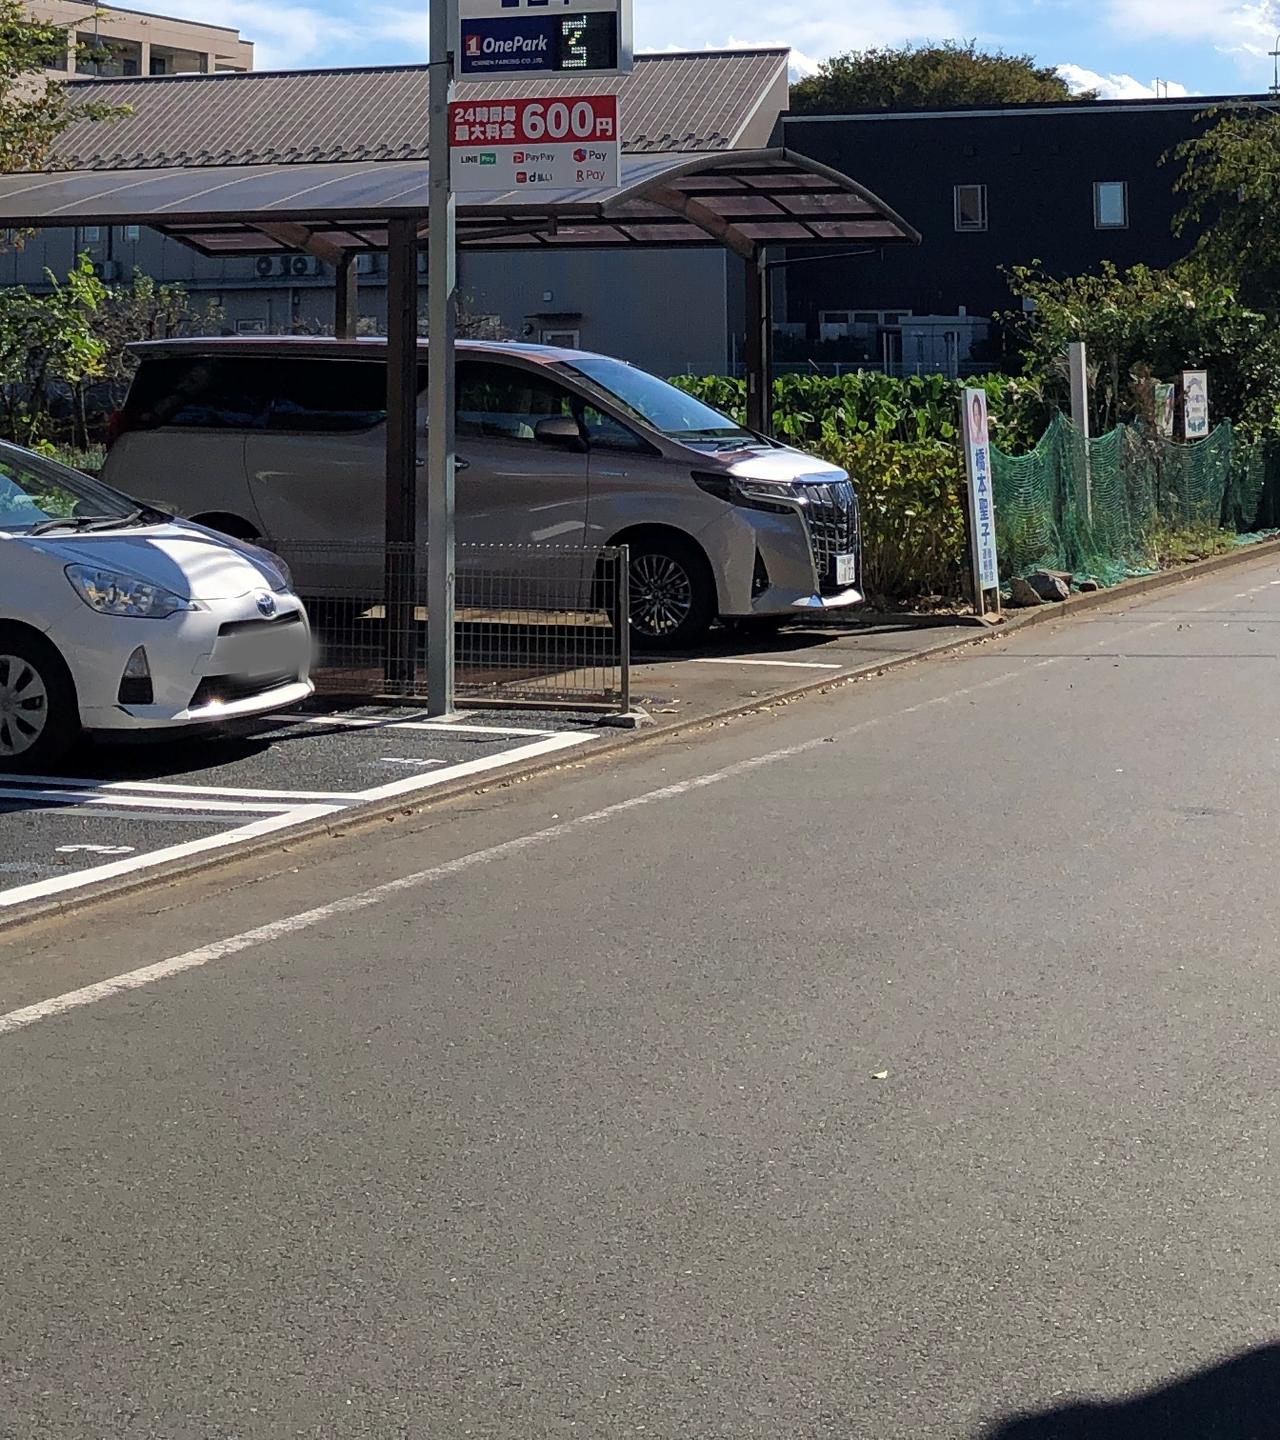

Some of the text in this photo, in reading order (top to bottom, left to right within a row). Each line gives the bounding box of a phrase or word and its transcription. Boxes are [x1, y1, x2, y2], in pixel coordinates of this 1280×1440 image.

[482, 34, 548, 53] OnePark
[454, 106, 516, 123] 24時間毎
[522, 101, 613, 139] 600円
[455, 123, 516, 140] 最大料金
[460, 155, 478, 164] LINE
[525, 152, 555, 163] PayPay
[588, 149, 608, 162] Pay
[586, 169, 605, 182] Pay
